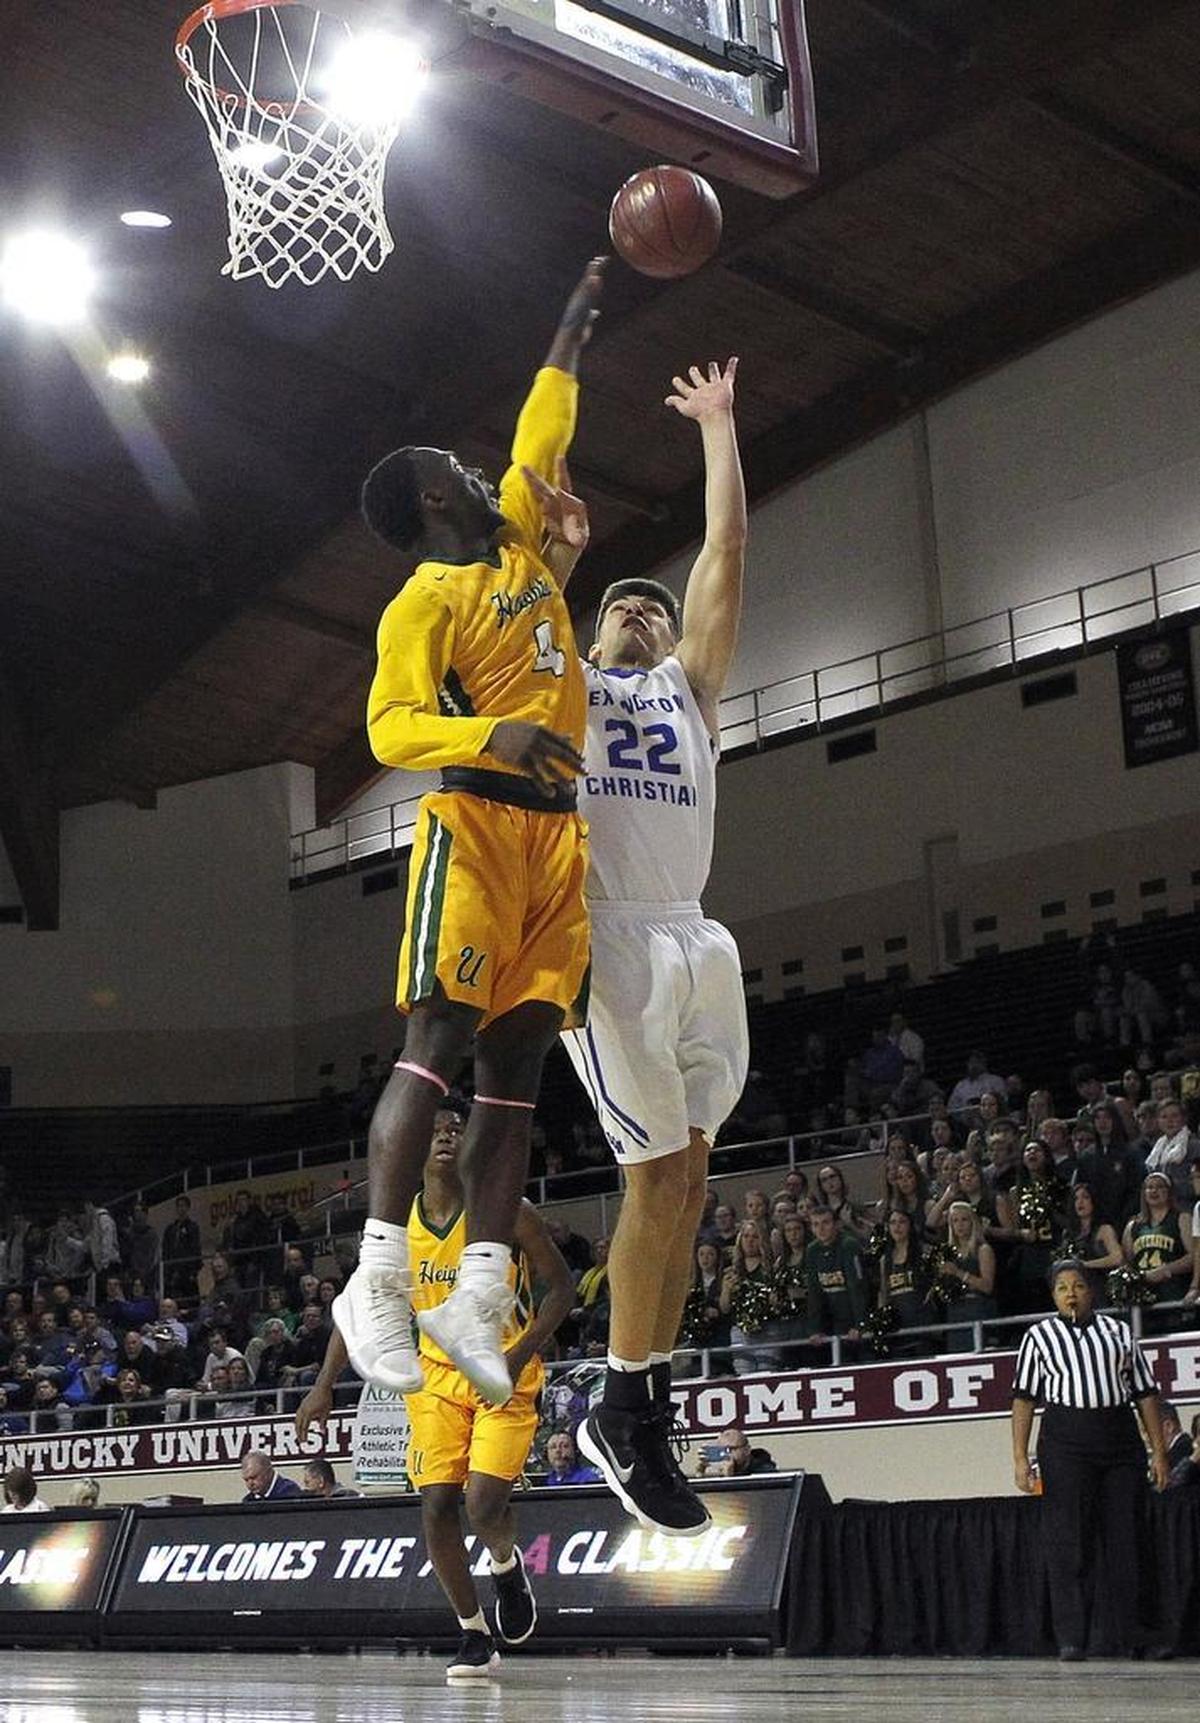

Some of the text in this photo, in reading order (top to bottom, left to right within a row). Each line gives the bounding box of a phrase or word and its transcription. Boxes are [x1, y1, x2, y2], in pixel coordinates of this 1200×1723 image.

[532, 619, 566, 677] 4
[605, 719, 681, 775] 22
[418, 1261, 460, 1288] Heig
[893, 1364, 994, 1411] OF
[0, 1418, 357, 1474] NTUCKY UNIVERSIT
[360, 1424, 403, 1436] Exclusive
[360, 1440, 396, 1452] Athletic
[356, 1456, 407, 1468] Rehabilita
[138, 1540, 326, 1583] WELCOMES
[333, 1537, 416, 1579] THE
[524, 1532, 551, 1575] A
[556, 1525, 748, 1575] CLASSIC
